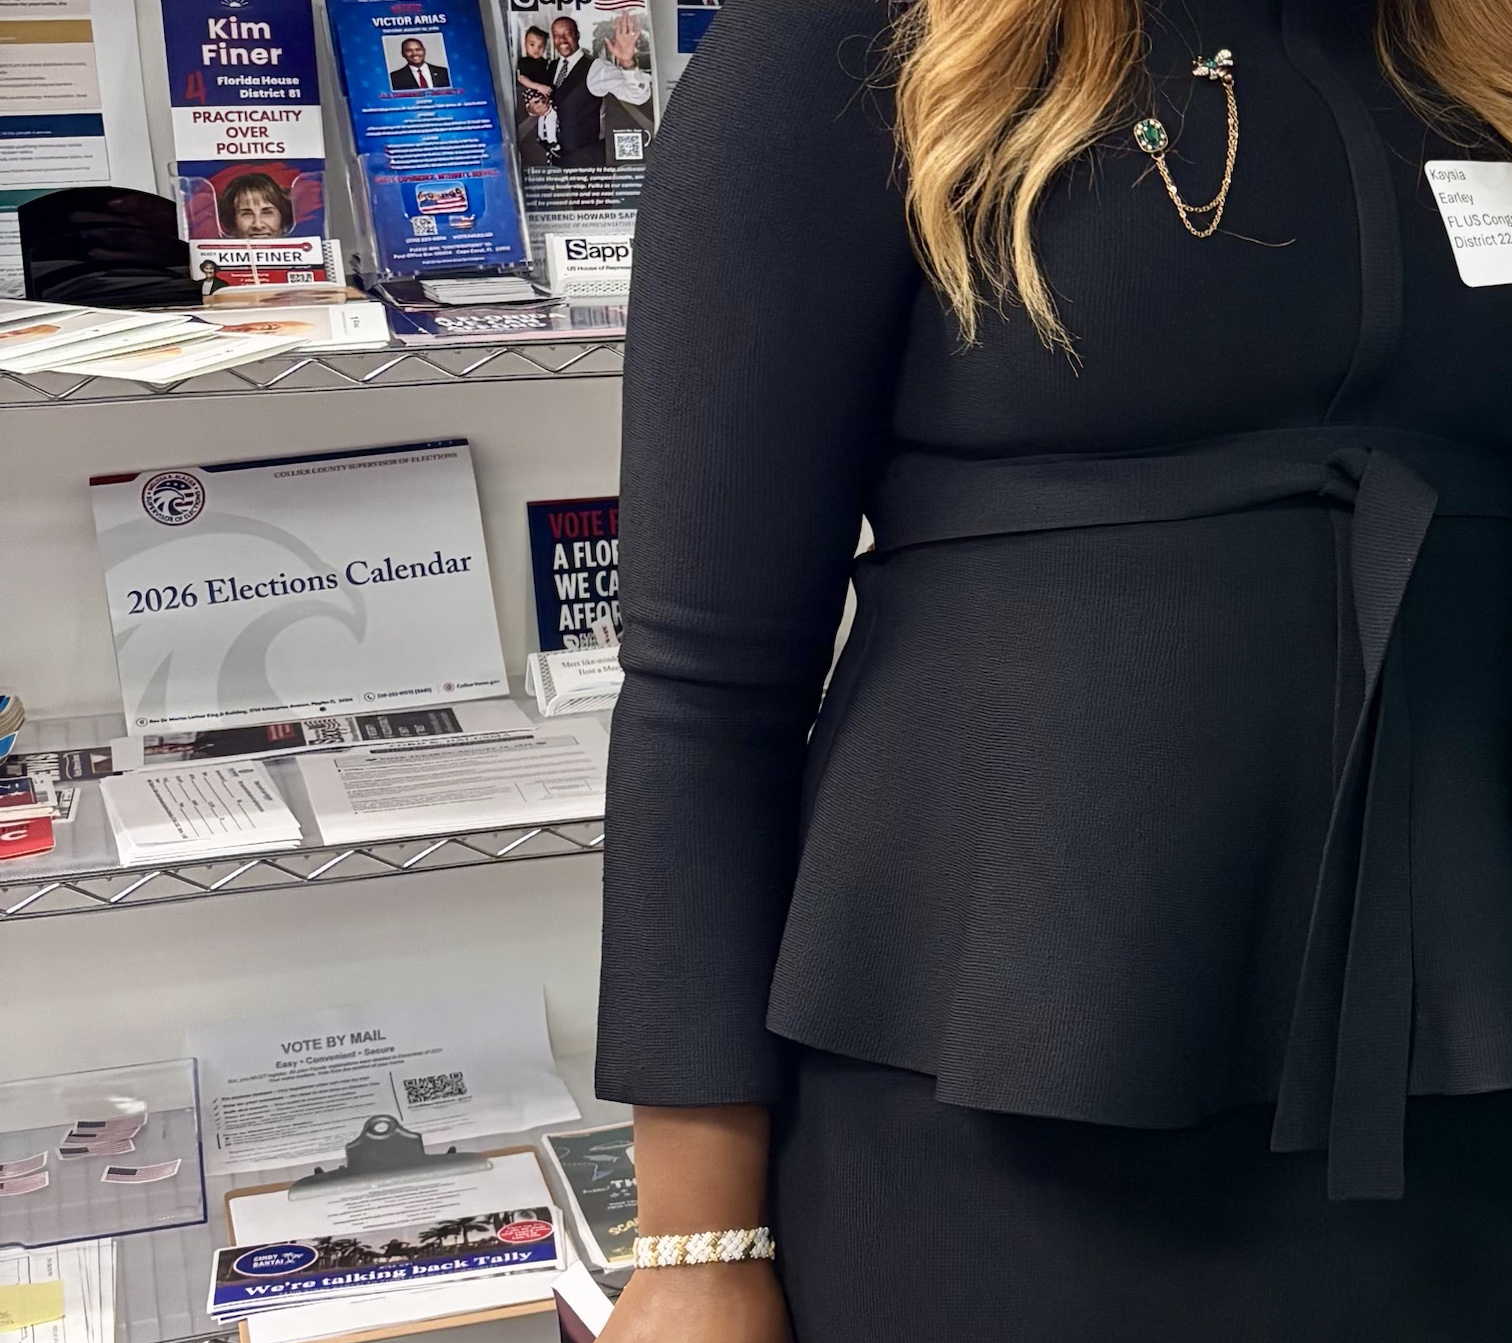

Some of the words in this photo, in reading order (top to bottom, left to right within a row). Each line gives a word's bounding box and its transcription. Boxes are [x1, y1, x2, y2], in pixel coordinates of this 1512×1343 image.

[372, 16, 412, 27] VICTOR
[414, 14, 446, 24] ARIAS
[208, 16, 271, 40] Kim
[202, 42, 282, 66] Finer
[217, 75, 260, 86] Florida
[261, 76, 299, 85] House
[240, 88, 285, 98] District
[288, 89, 301, 98] 81
[192, 110, 302, 124] PRACTICALITY
[226, 126, 269, 138] OVER
[217, 142, 285, 155] POLITICS
[1429, 169, 1466, 183] Kaysia
[1439, 192, 1474, 205] Earley
[529, 213, 575, 221] REVEREND
[577, 212, 616, 220] HOWARD
[1448, 216, 1463, 228] FL
[1466, 214, 1482, 226] US
[1454, 234, 1498, 249] District
[219, 252, 250, 262] KIM
[256, 251, 302, 262] FINER
[567, 240, 629, 262] Sapp
[274, 468, 311, 478] COLLIER
[312, 464, 346, 474] COUNTY
[349, 459, 397, 470] SUPERVISOR
[411, 452, 457, 463] ELECTIONS
[548, 511, 604, 539] VOTE
[553, 543, 569, 571] A
[127, 583, 197, 615] 2026
[204, 564, 338, 606] Elections
[345, 551, 472, 588] Calendar
[554, 572, 591, 600] WE
[281, 1038, 322, 1055] VOTE
[326, 1035, 346, 1047] BY
[350, 1029, 386, 1044] MAIL
[276, 1059, 298, 1070] Easy
[306, 1050, 356, 1065] Convenient
[364, 1046, 395, 1056] Secure
[253, 1254, 278, 1262] CINDY
[245, 1281, 316, 1296] We're
[322, 1266, 407, 1286] talking
[412, 1259, 469, 1274] back
[473, 1252, 532, 1266] Tally
